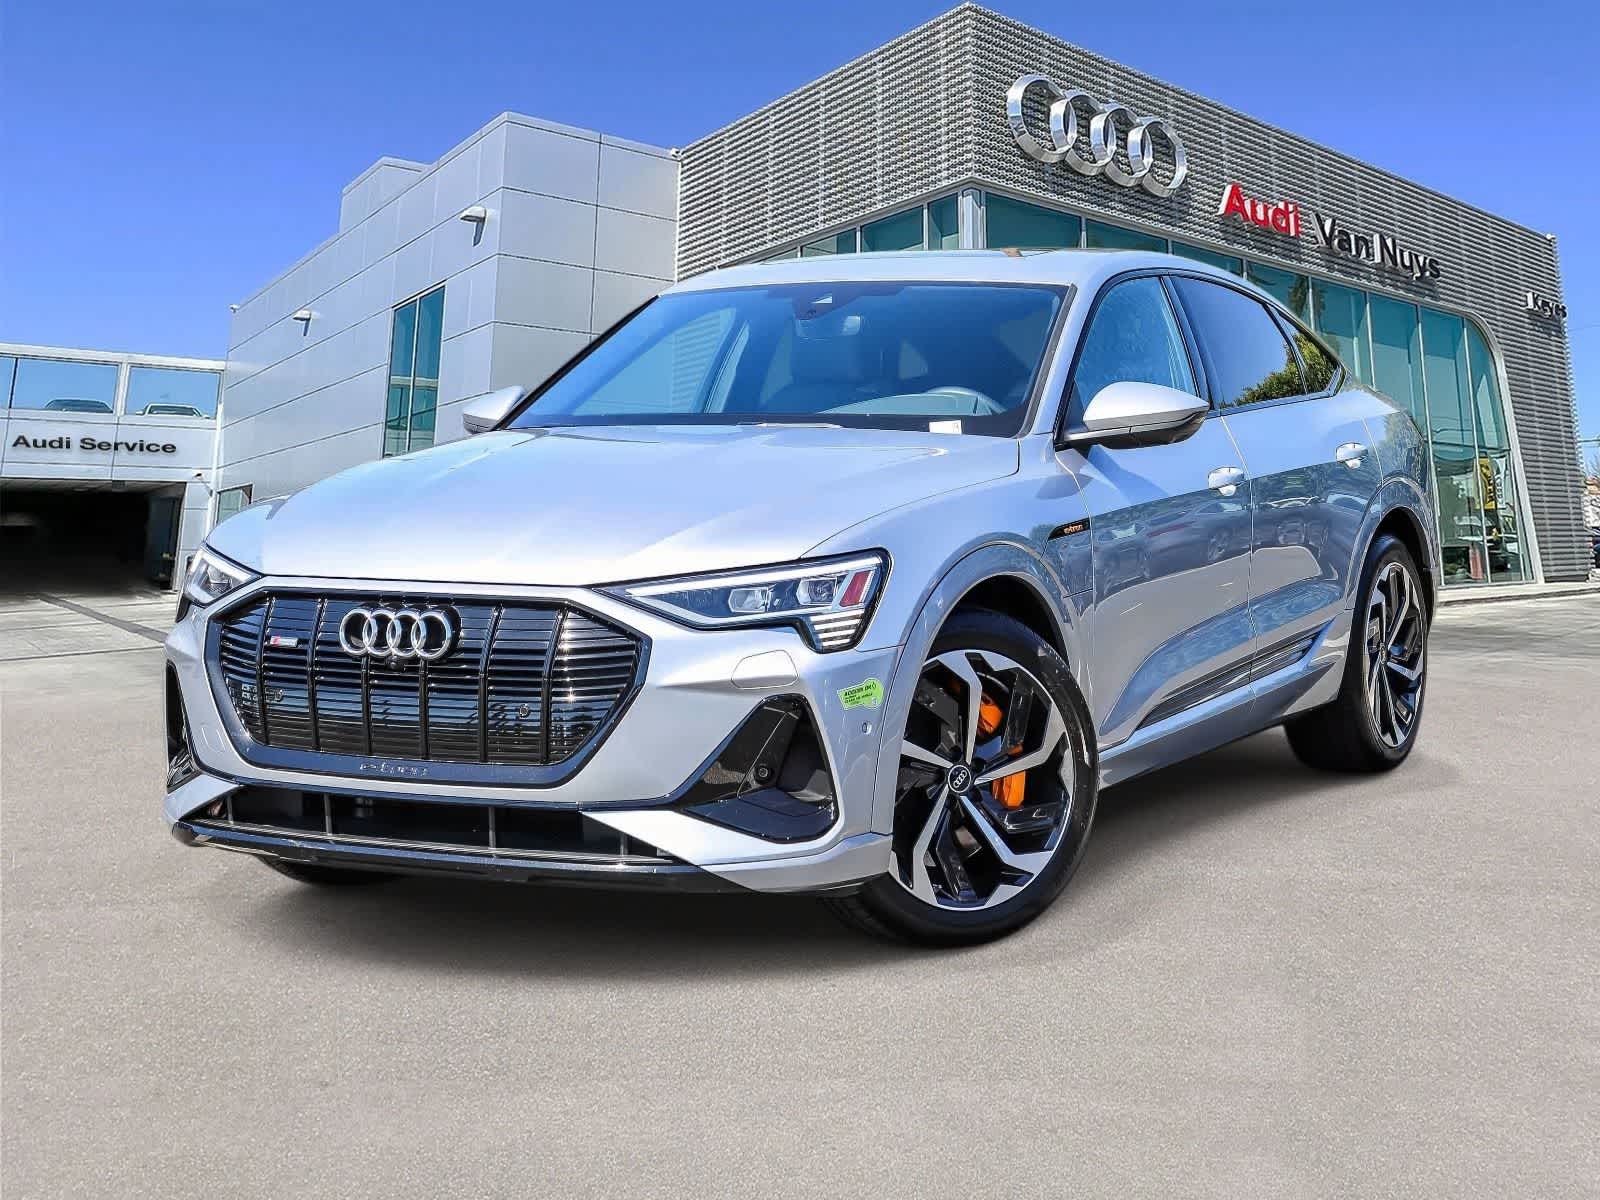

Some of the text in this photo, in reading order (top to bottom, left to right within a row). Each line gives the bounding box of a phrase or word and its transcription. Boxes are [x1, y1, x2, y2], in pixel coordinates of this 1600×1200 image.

[1217, 183, 1440, 280] Audi Van Nuys
[12, 435, 177, 454] Audi Service
